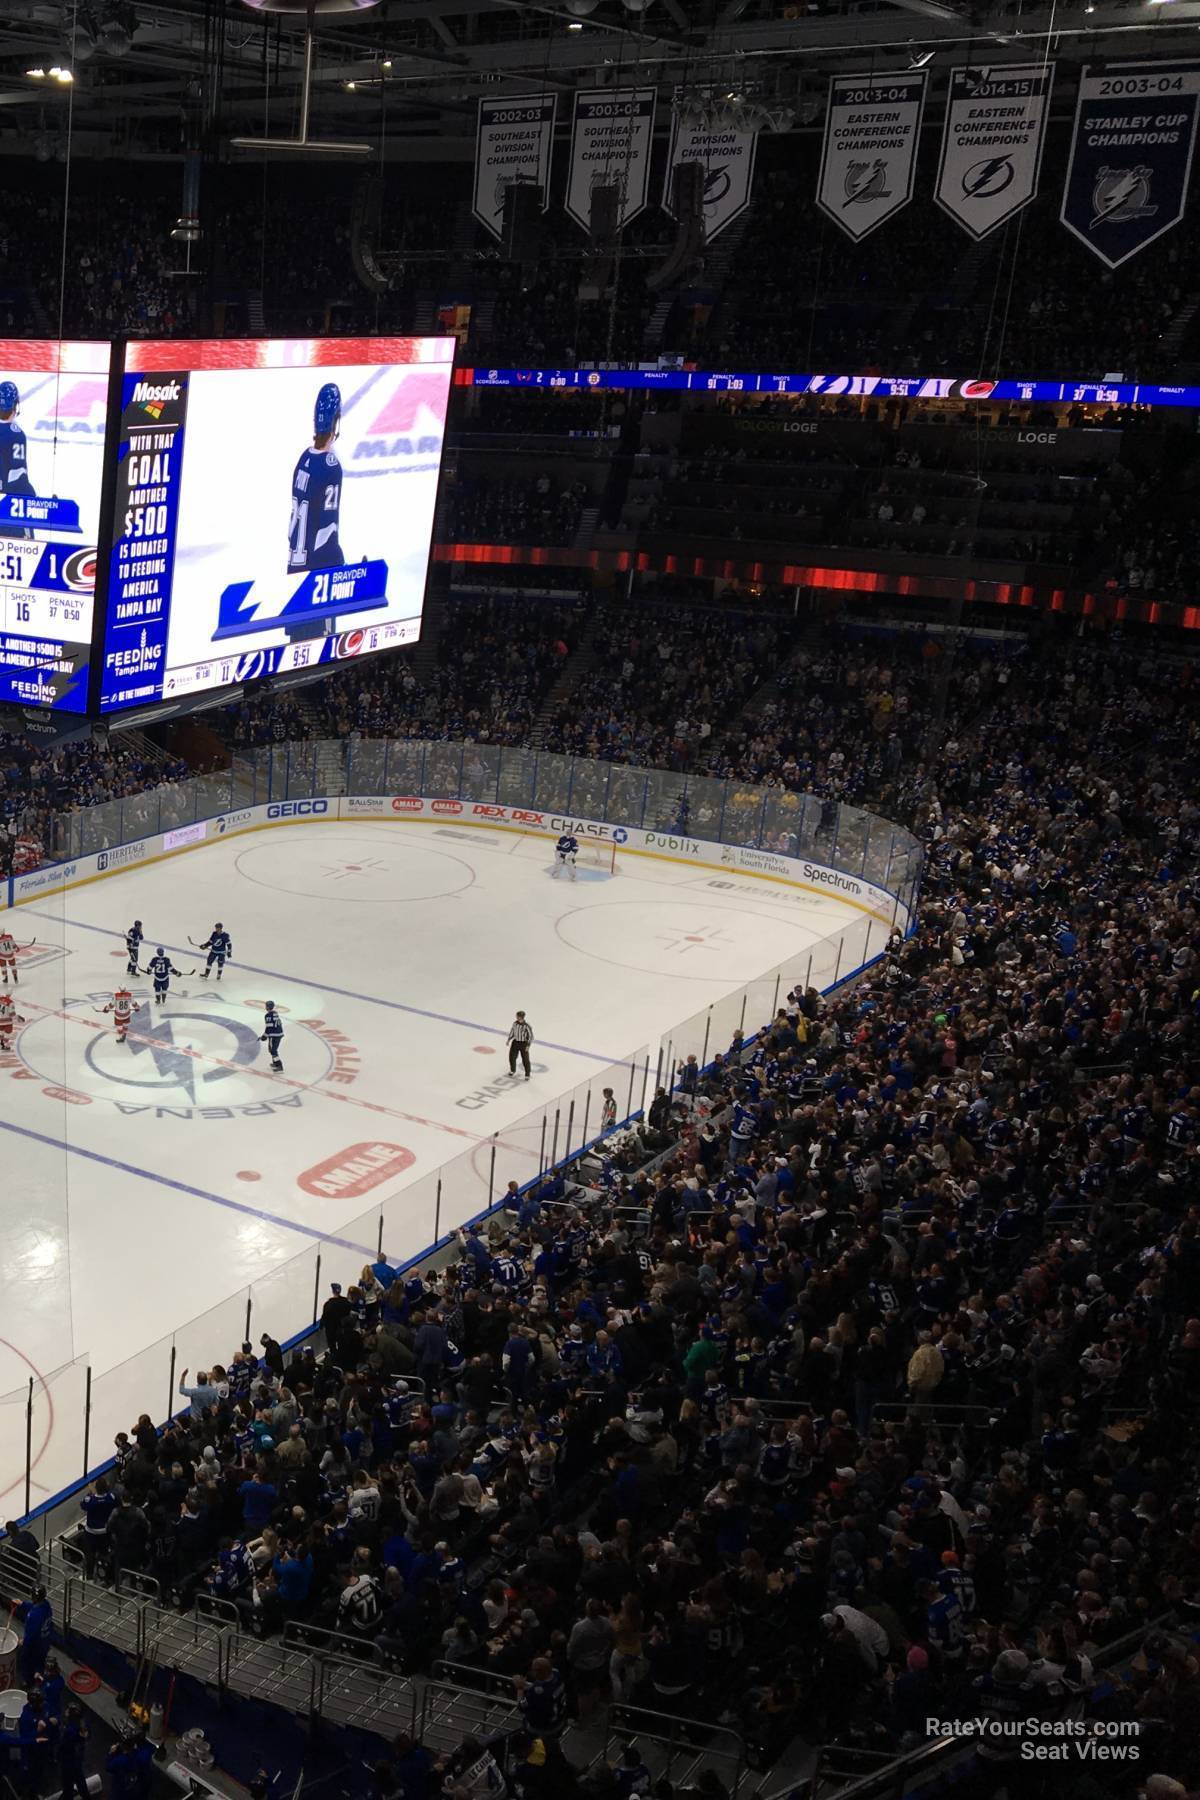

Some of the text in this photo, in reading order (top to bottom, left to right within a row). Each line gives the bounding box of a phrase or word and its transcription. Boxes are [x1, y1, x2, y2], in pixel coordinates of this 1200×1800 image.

[970, 81, 1030, 96] 2014-15
[1100, 77, 1183, 94] 2003-04
[492, 109, 543, 122] 2002-03
[588, 103, 640, 116] 2003-04
[968, 107, 1025, 119] EASTERN
[847, 112, 900, 124] EASTERN
[1084, 114, 1188, 130] STANLEY CUP
[584, 125, 641, 137] SOUTHEAST
[834, 125, 911, 137] CONFERENCE
[954, 120, 1036, 133] CONFERENCE
[488, 130, 542, 142] SOUTHEAST
[590, 138, 631, 148] DIVISION
[691, 135, 736, 145] DIVISION
[957, 134, 1029, 146] CHAMPIONS
[1087, 132, 1179, 146] CHAMPIONS
[495, 143, 534, 153] DIVISION
[681, 146, 743, 158] CHAMPIONS
[837, 139, 904, 150] CHAMPIONS
[487, 154, 540, 165] CHAMPIONS
[582, 150, 639, 161] CHAMPIONS
[537, 372, 543, 383] 2
[574, 372, 579, 383] 1
[707, 378, 744, 390] 91 1:03
[132, 380, 180, 402] Mosaic
[778, 380, 785, 391] 11
[860, 378, 867, 394] 1
[890, 384, 909, 396] 9:51
[934, 380, 941, 396] 1
[1021, 388, 1033, 399] 16
[1073, 389, 1119, 402] 37 0:50
[783, 422, 818, 433] LOGE
[130, 433, 174, 451] WITH THAT
[1017, 432, 1057, 444] LOGE
[12, 444, 25, 459] 21
[128, 453, 170, 486] GOAL
[128, 487, 167, 505] ANOTHER
[324, 485, 339, 510] 21
[10, 498, 24, 518] 21
[26, 500, 58, 509] BRAYDEN
[26, 508, 48, 519] POINT
[125, 505, 168, 538] $500
[7, 543, 39, 555] Period
[120, 539, 168, 559] IS DONATED
[49, 554, 57, 579] 1
[119, 559, 166, 579] TO FEEDING
[333, 568, 367, 583] BRAYDEN
[122, 579, 158, 598] AMERICA
[312, 575, 329, 604] 21
[330, 581, 355, 601] POINT
[10, 592, 36, 603] SHOTS
[49, 597, 84, 608] PENALTY
[16, 603, 30, 621] 16
[49, 606, 80, 621] 37 0:50
[117, 598, 163, 619] TAMPA BAY
[6, 638, 36, 653] ANOTHER
[37, 643, 55, 656] $500
[55, 645, 63, 657] IS
[6, 652, 35, 667] AMERICA
[60, 660, 74, 673] BAY
[106, 644, 162, 668] FEEDING
[268, 650, 274, 672] 1
[293, 648, 310, 667] 9:51
[115, 662, 157, 677] Tampa Bay
[222, 665, 229, 681] 11
[11, 680, 57, 697] FEEDING
[18, 691, 53, 704] Tampa Bay
[267, 800, 328, 819] GEICO
[472, 805, 507, 818] DEX
[511, 810, 544, 824] DEX
[551, 818, 610, 836] CHASE
[645, 833, 699, 854] Publix
[109, 843, 145, 860] HERITAGE
[740, 849, 778, 865] University
[739, 857, 790, 875] South Florida
[804, 864, 858, 895] Spectrum
[156, 964, 166, 974] 21
[297, 1018, 361, 1085] AMALIE
[114, 1094, 303, 1120] ARENA
[309, 1145, 405, 1195] AMALIE
